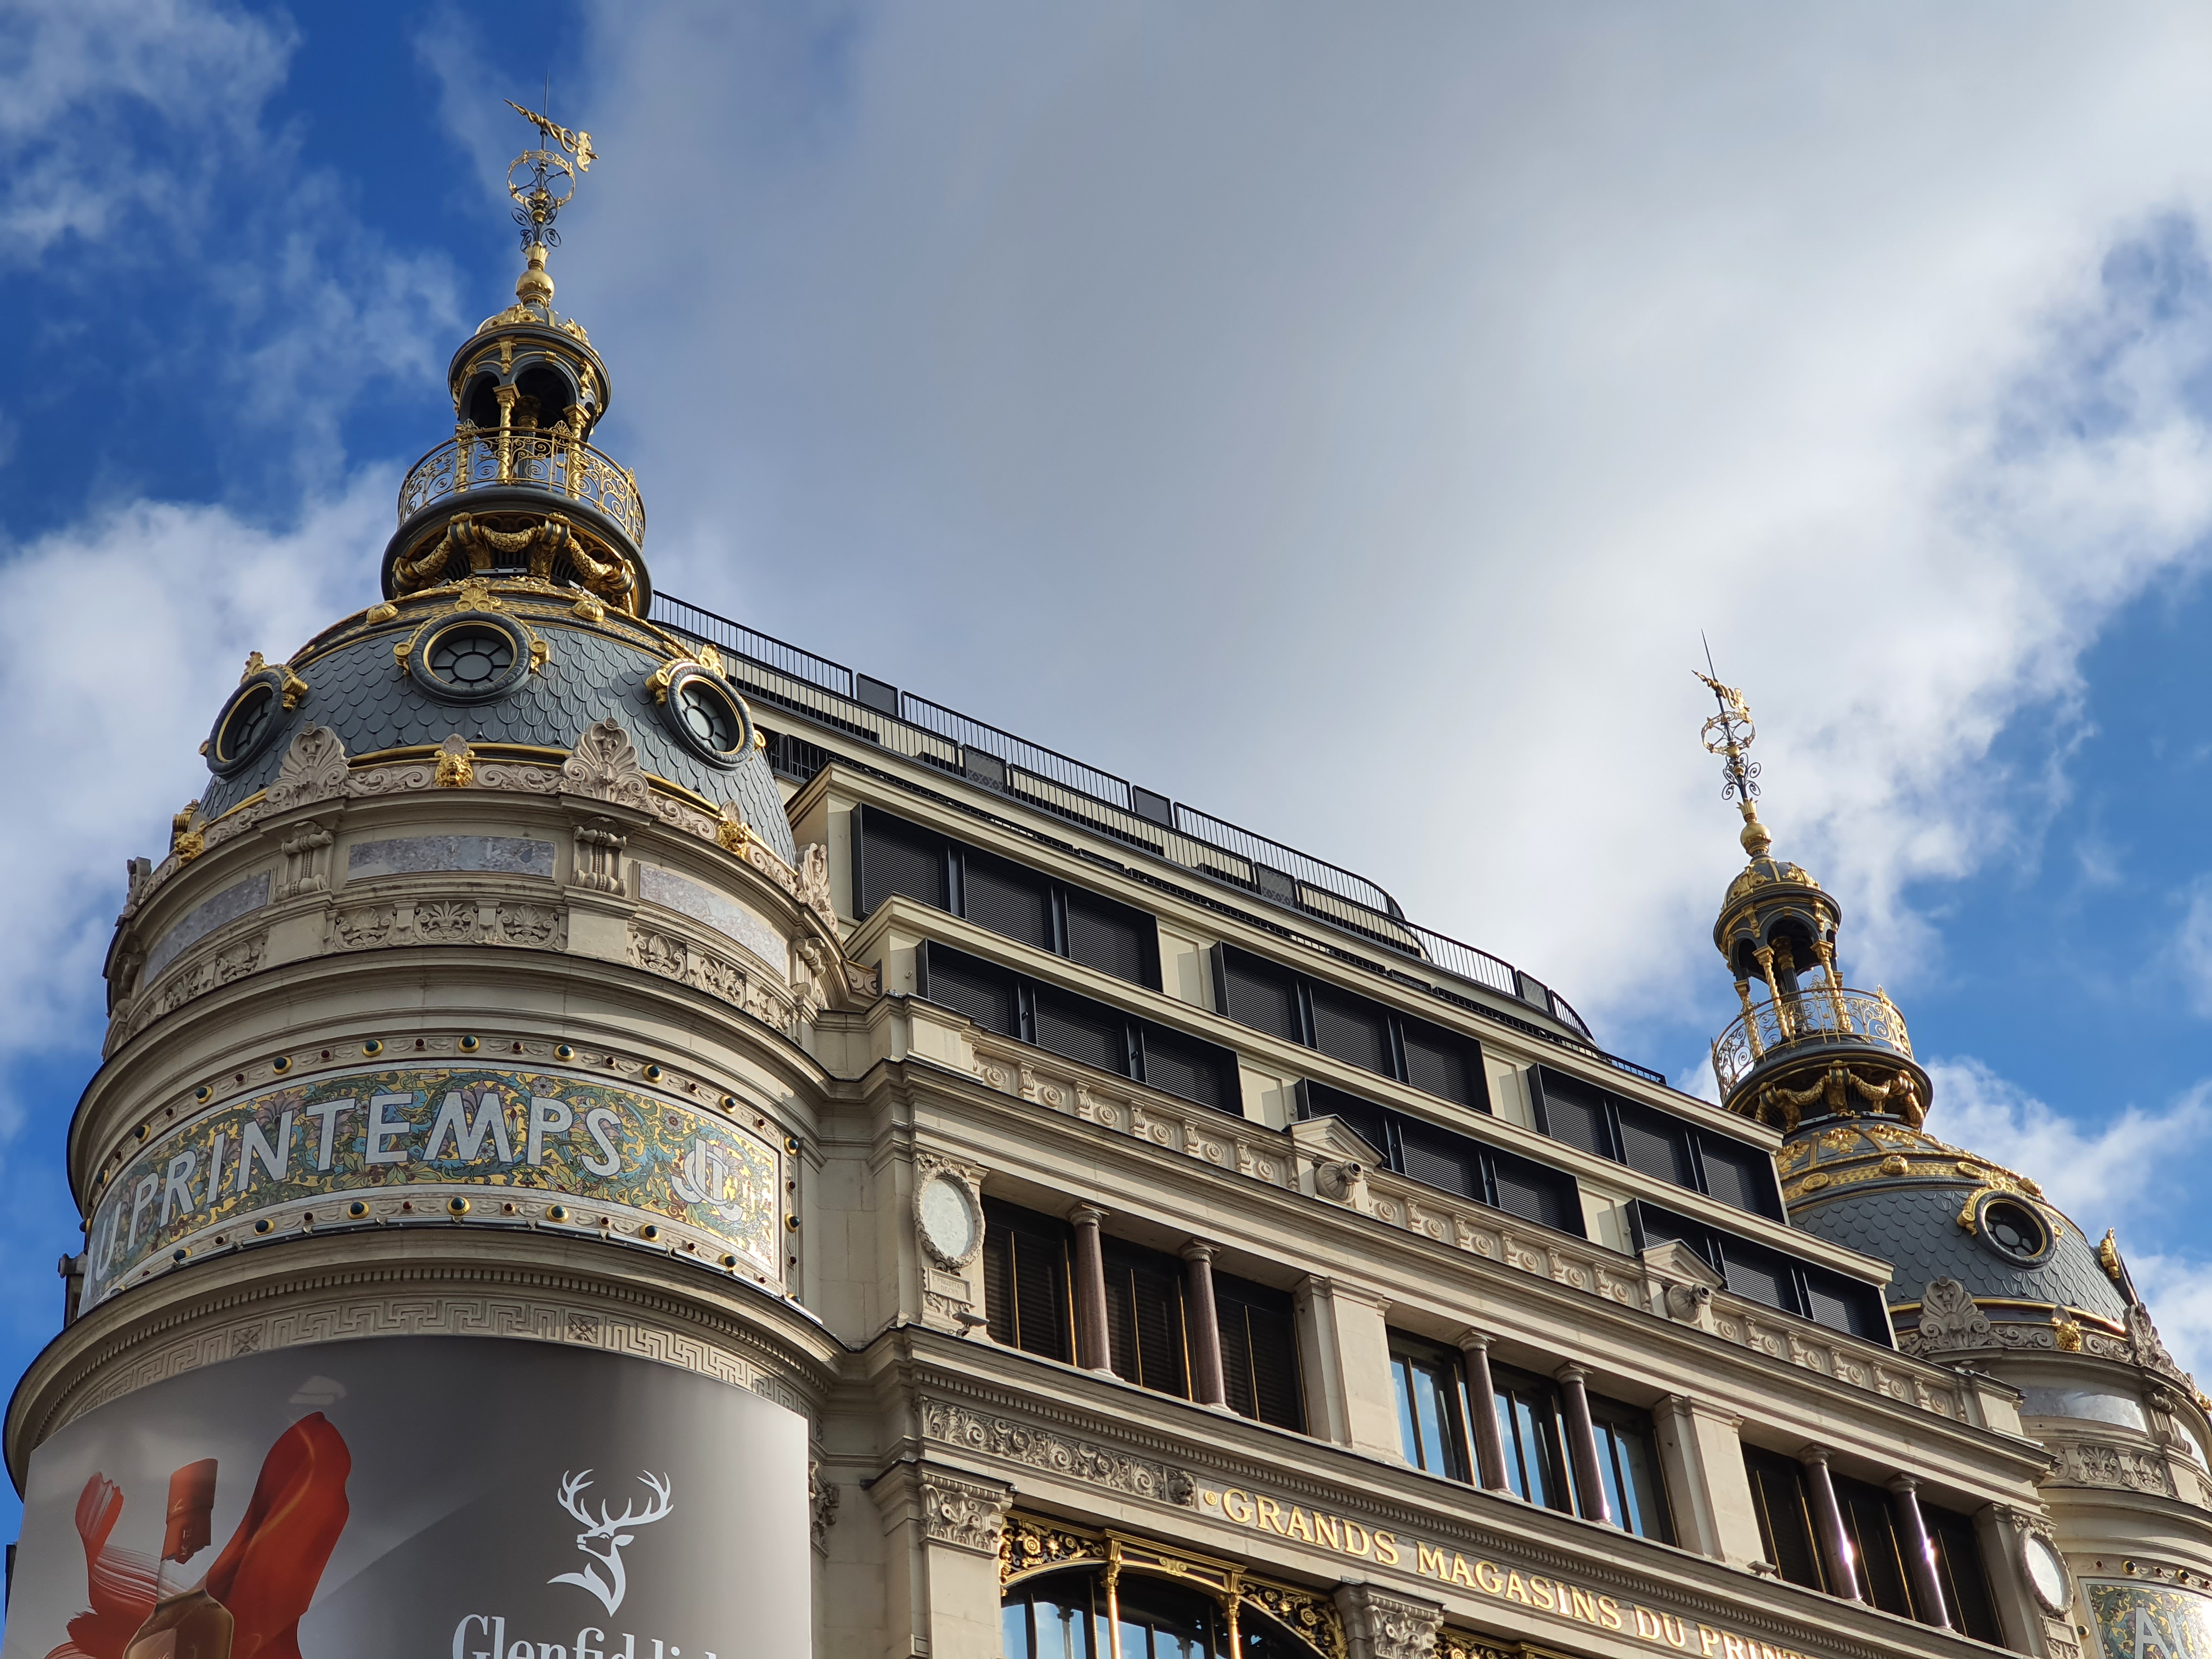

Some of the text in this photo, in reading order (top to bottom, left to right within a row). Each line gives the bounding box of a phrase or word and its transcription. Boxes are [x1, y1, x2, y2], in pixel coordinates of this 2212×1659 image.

[127, 1091, 622, 1251] PRINTEMPS
[1222, 1488, 1400, 1566] GRANDS
[1415, 1540, 1623, 1630] MAGASINS
[1633, 1604, 1686, 1648] DU
